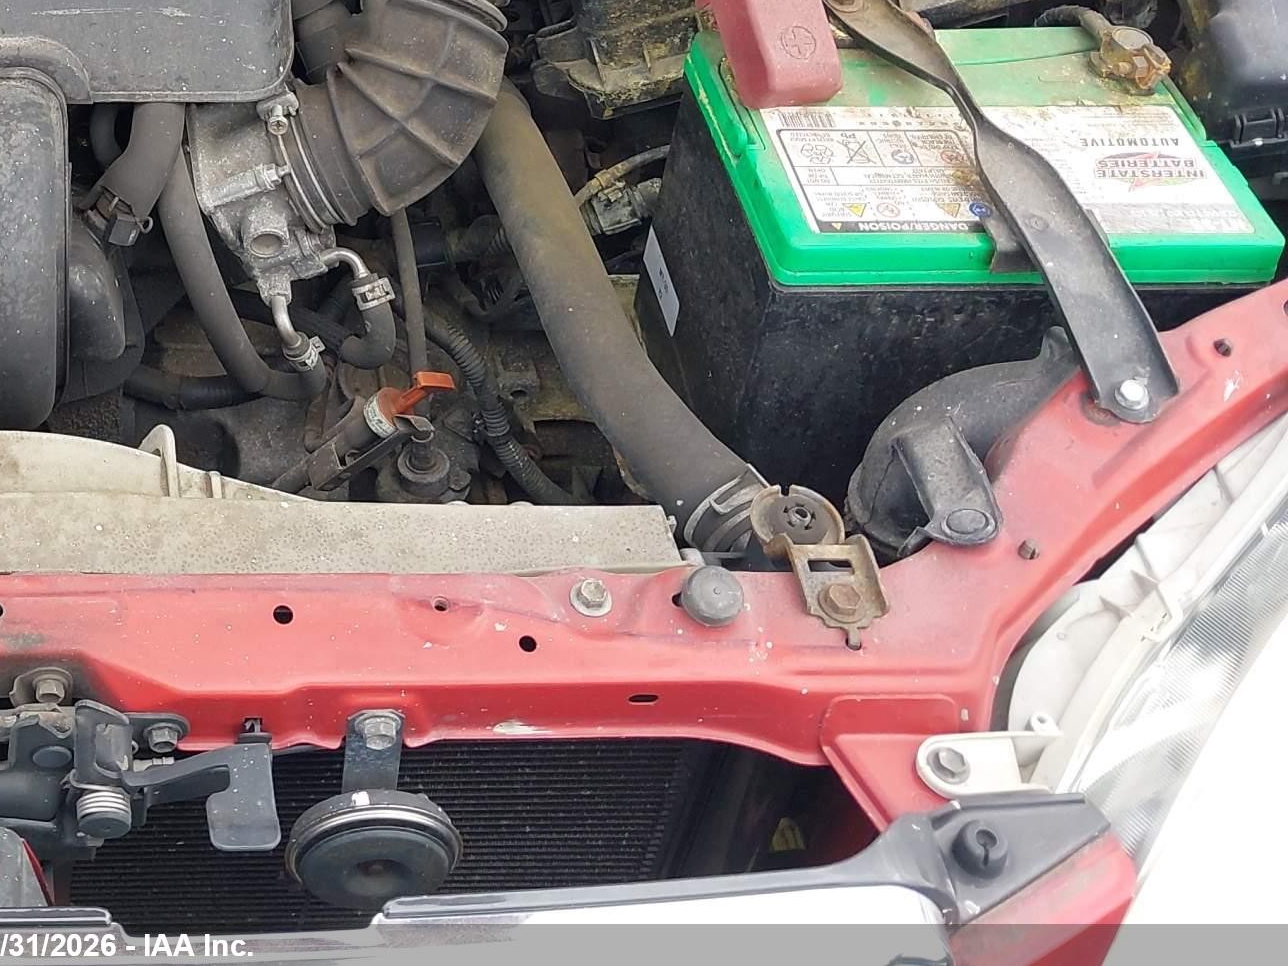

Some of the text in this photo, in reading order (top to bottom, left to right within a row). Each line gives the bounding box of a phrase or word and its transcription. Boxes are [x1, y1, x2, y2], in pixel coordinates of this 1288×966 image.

[1079, 138, 1180, 147] AUTOMOTIVE
[1096, 159, 1195, 168] BATTERIES
[1096, 169, 1205, 178] INTERSTATE
[859, 222, 969, 232] DANGER/POISON
